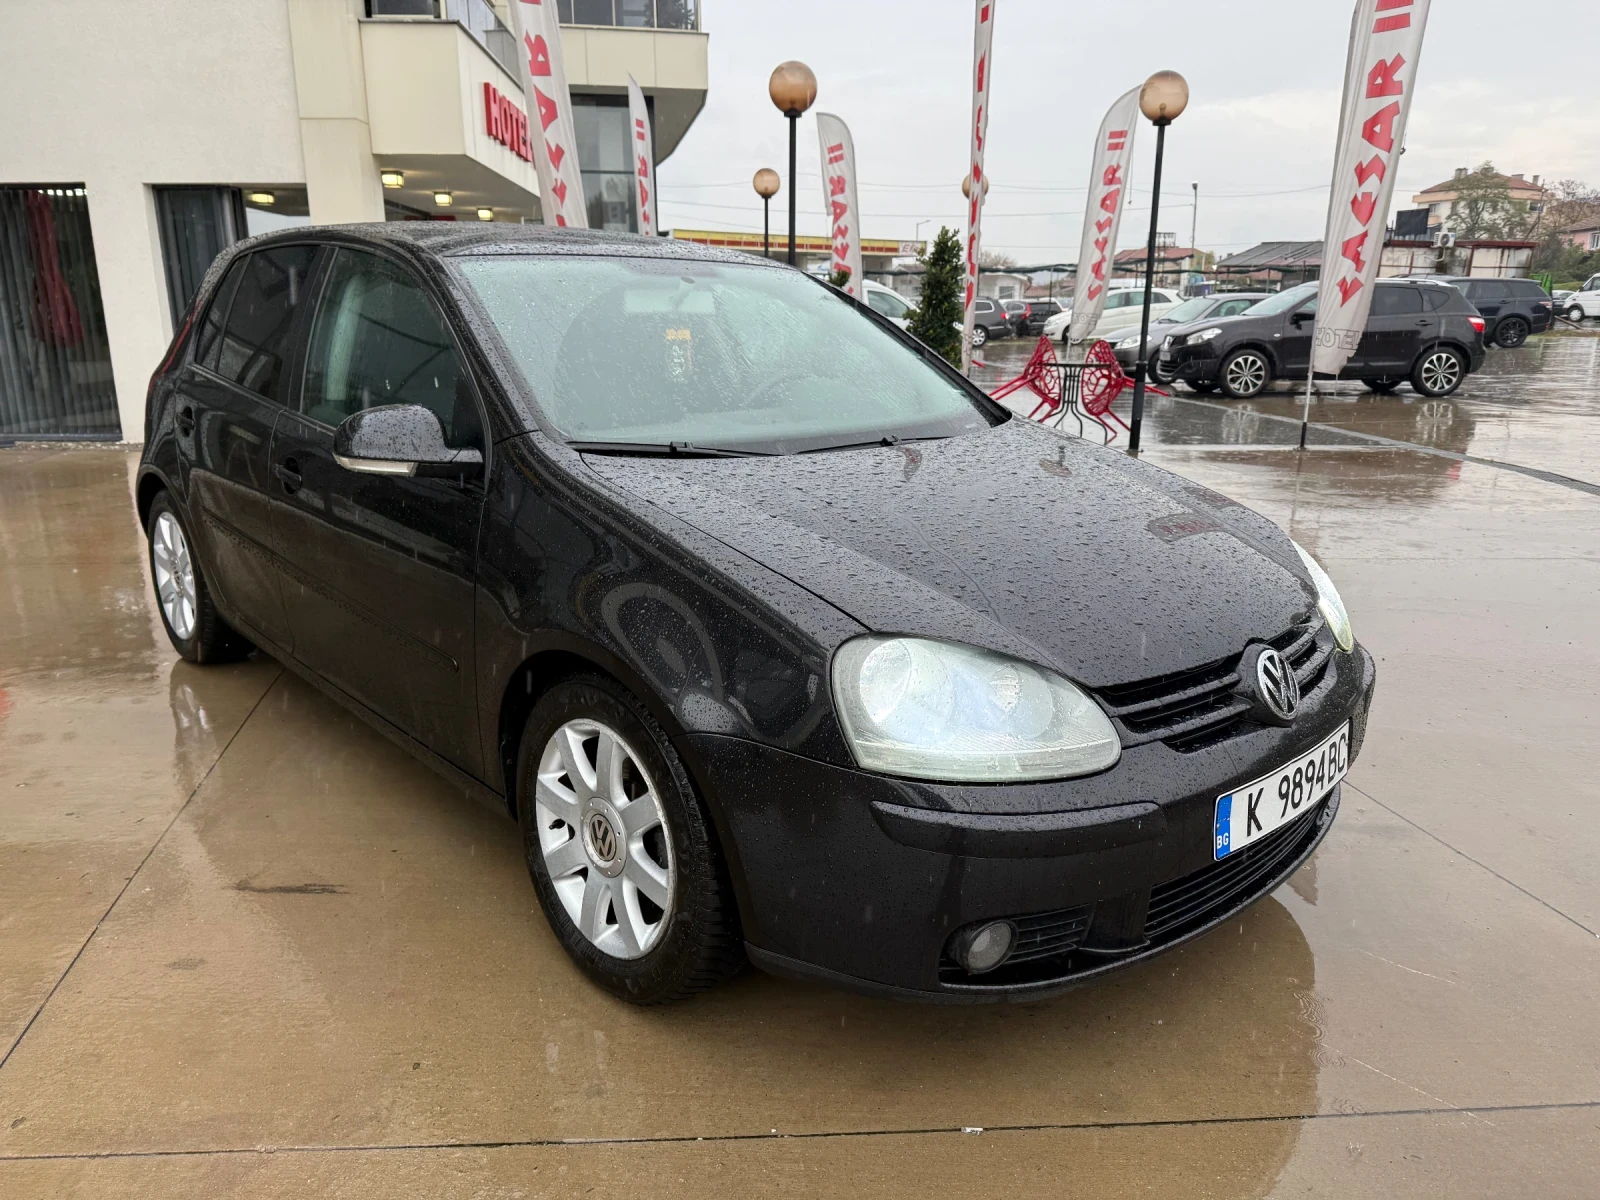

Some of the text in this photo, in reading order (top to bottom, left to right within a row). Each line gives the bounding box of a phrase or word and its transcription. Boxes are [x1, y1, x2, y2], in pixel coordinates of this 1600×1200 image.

[483, 82, 534, 162] HOTEL
[1247, 787, 1264, 837] K
[1216, 832, 1230, 850] BG
